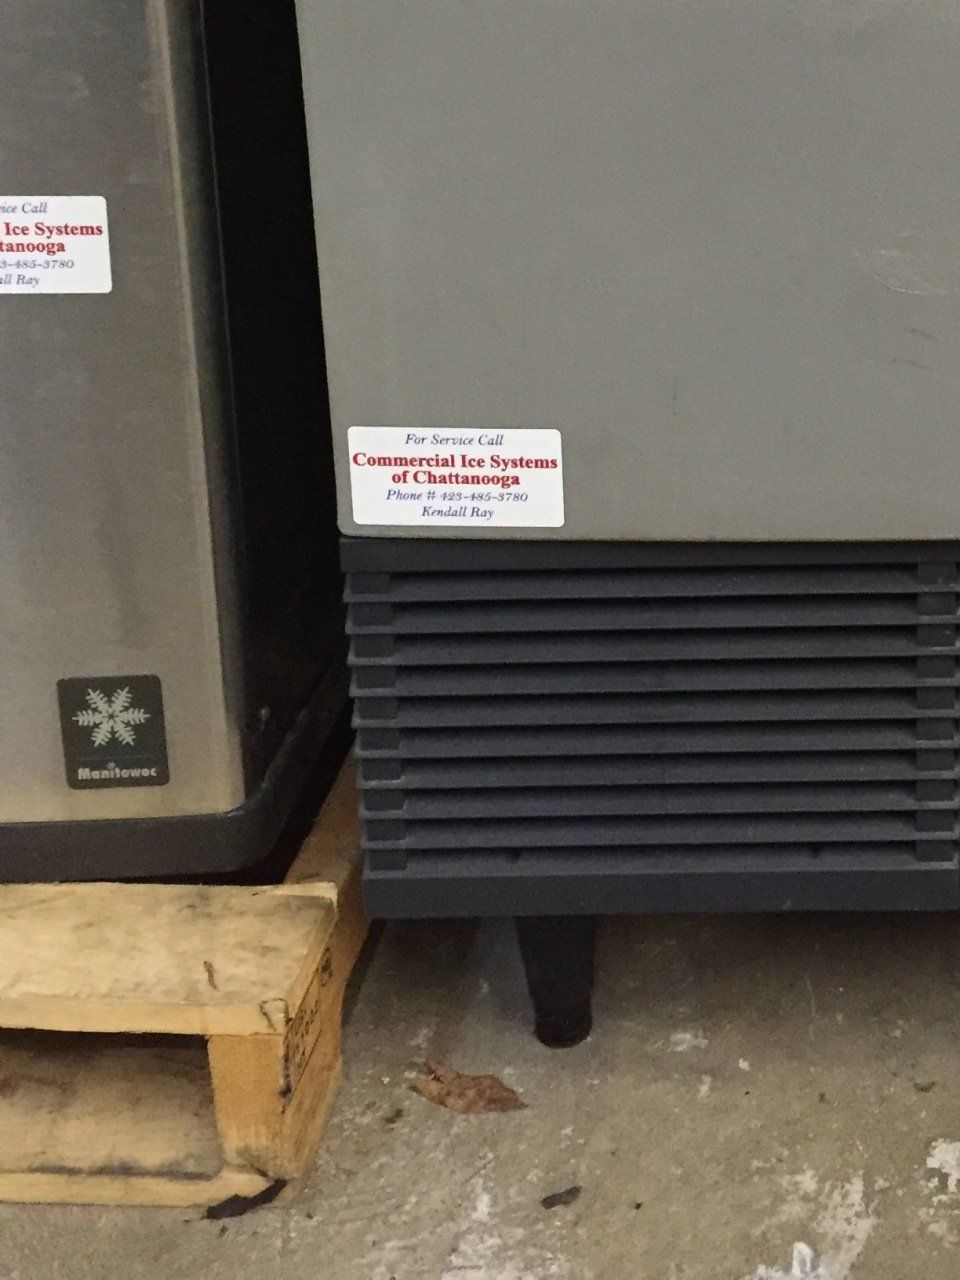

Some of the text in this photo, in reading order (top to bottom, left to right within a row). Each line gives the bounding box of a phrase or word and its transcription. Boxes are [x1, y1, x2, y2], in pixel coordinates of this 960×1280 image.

[22, 202, 48, 214] Call
[4, 221, 104, 239] Ice Systems
[16, 274, 40, 288] Ray
[405, 433, 504, 446] For Service Call
[352, 452, 558, 471] Commercial Ice Systems
[391, 471, 521, 488] of Chattanooga
[386, 489, 529, 502] Phone # 423-485-3780
[422, 506, 494, 521] Kendall Ray
[78, 764, 157, 780] Manitowoc
